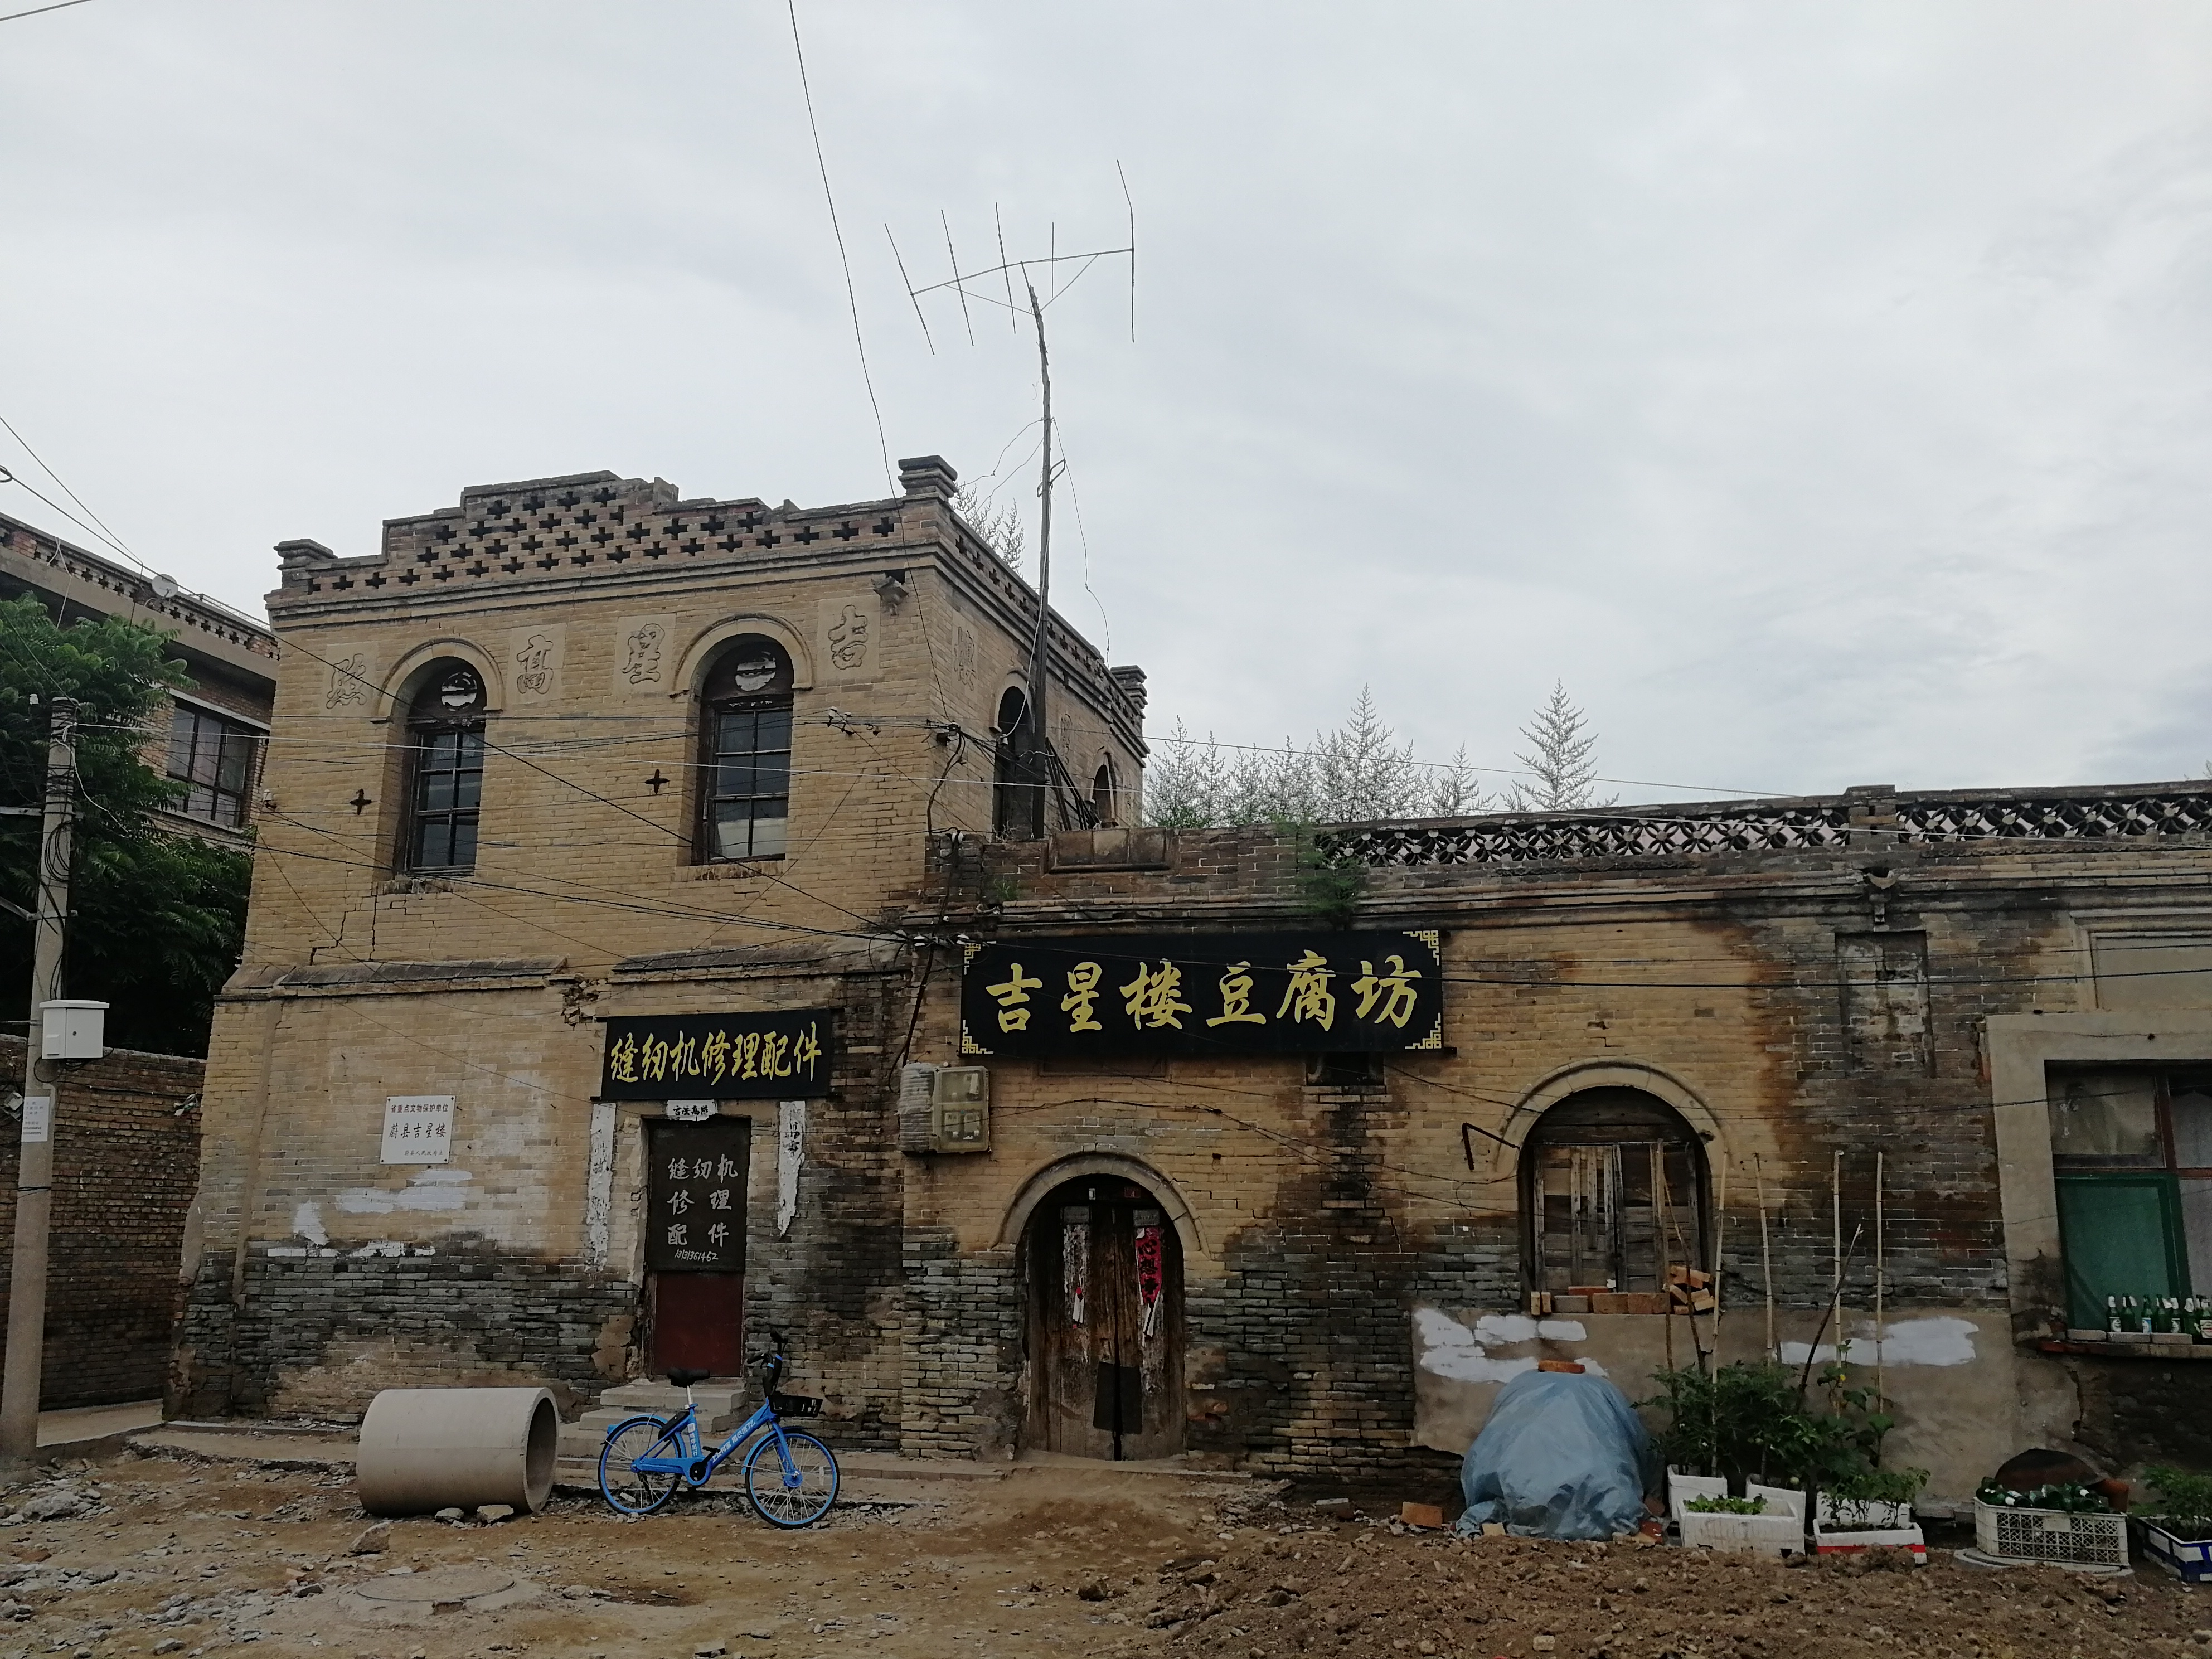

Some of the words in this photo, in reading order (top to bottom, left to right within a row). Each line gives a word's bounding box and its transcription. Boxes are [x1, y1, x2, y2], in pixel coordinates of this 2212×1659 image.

[985, 949, 1422, 1034] 吉星楼豆腐坊
[611, 1021, 822, 1086] 缝纫机修理配件
[391, 1103, 449, 1113] 省重点文物保护单位
[389, 1122, 447, 1139] 蔚县吉星楼
[667, 1153, 739, 1184] 缝纫机
[667, 1189, 732, 1215] 修理
[667, 1221, 729, 1248] 配件
[674, 1249, 719, 1263] 13131361462
